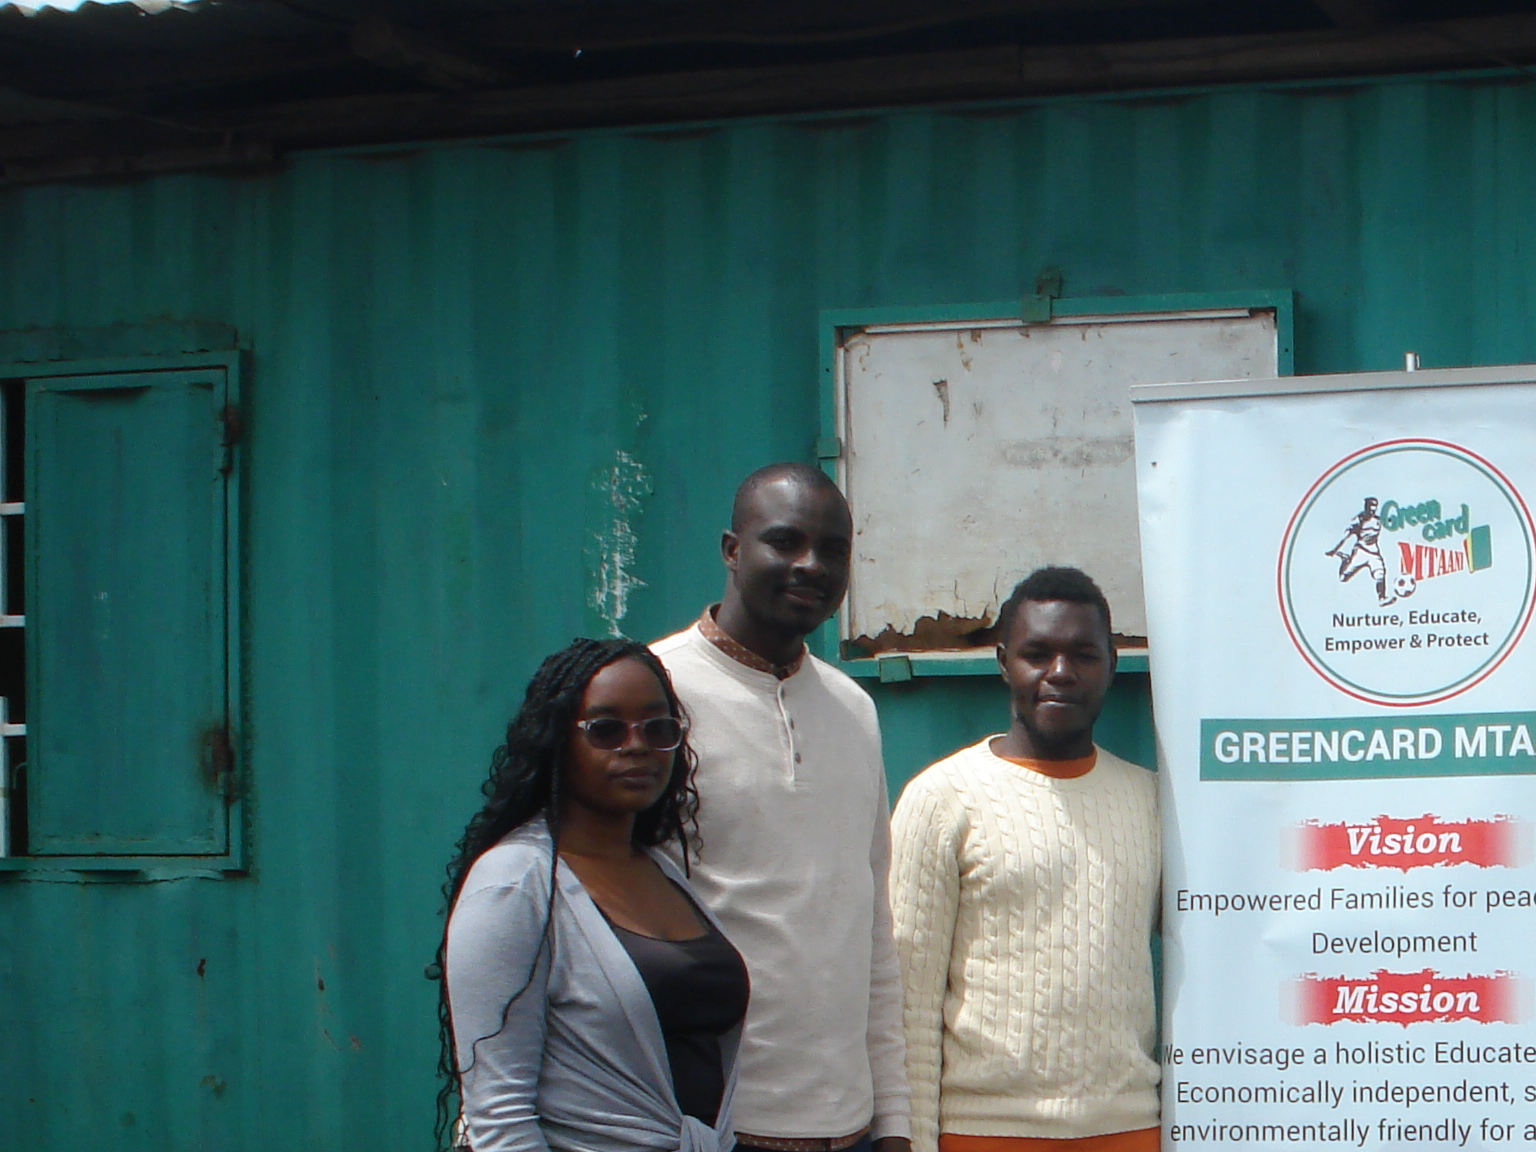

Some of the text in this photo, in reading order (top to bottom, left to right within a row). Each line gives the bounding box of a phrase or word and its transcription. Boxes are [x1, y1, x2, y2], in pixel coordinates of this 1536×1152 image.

[1379, 499, 1441, 532] Green
[1398, 541, 1464, 581] MTAANI
[1333, 610, 1481, 627] Nurture, Educate,
[1326, 633, 1488, 654] Empower & Protect
[1215, 728, 1442, 762] GREENCARD
[1347, 826, 1462, 855] Vision
[1178, 888, 1321, 916] Empowered
[1332, 886, 1433, 909] Families
[1443, 885, 1477, 907] for
[1313, 930, 1477, 958] Development
[1333, 984, 1480, 1013] Mission
[1192, 1042, 1304, 1070] envisage
[1314, 1048, 1326, 1064] a
[1337, 1041, 1425, 1064] holistic
[1178, 1080, 1344, 1108] Economically
[1353, 1079, 1514, 1108] independent,
[1171, 1119, 1369, 1147] environmentally
[1378, 1118, 1471, 1147] friendly
[1480, 1118, 1515, 1141] for
[1524, 1125, 1536, 1140] a
